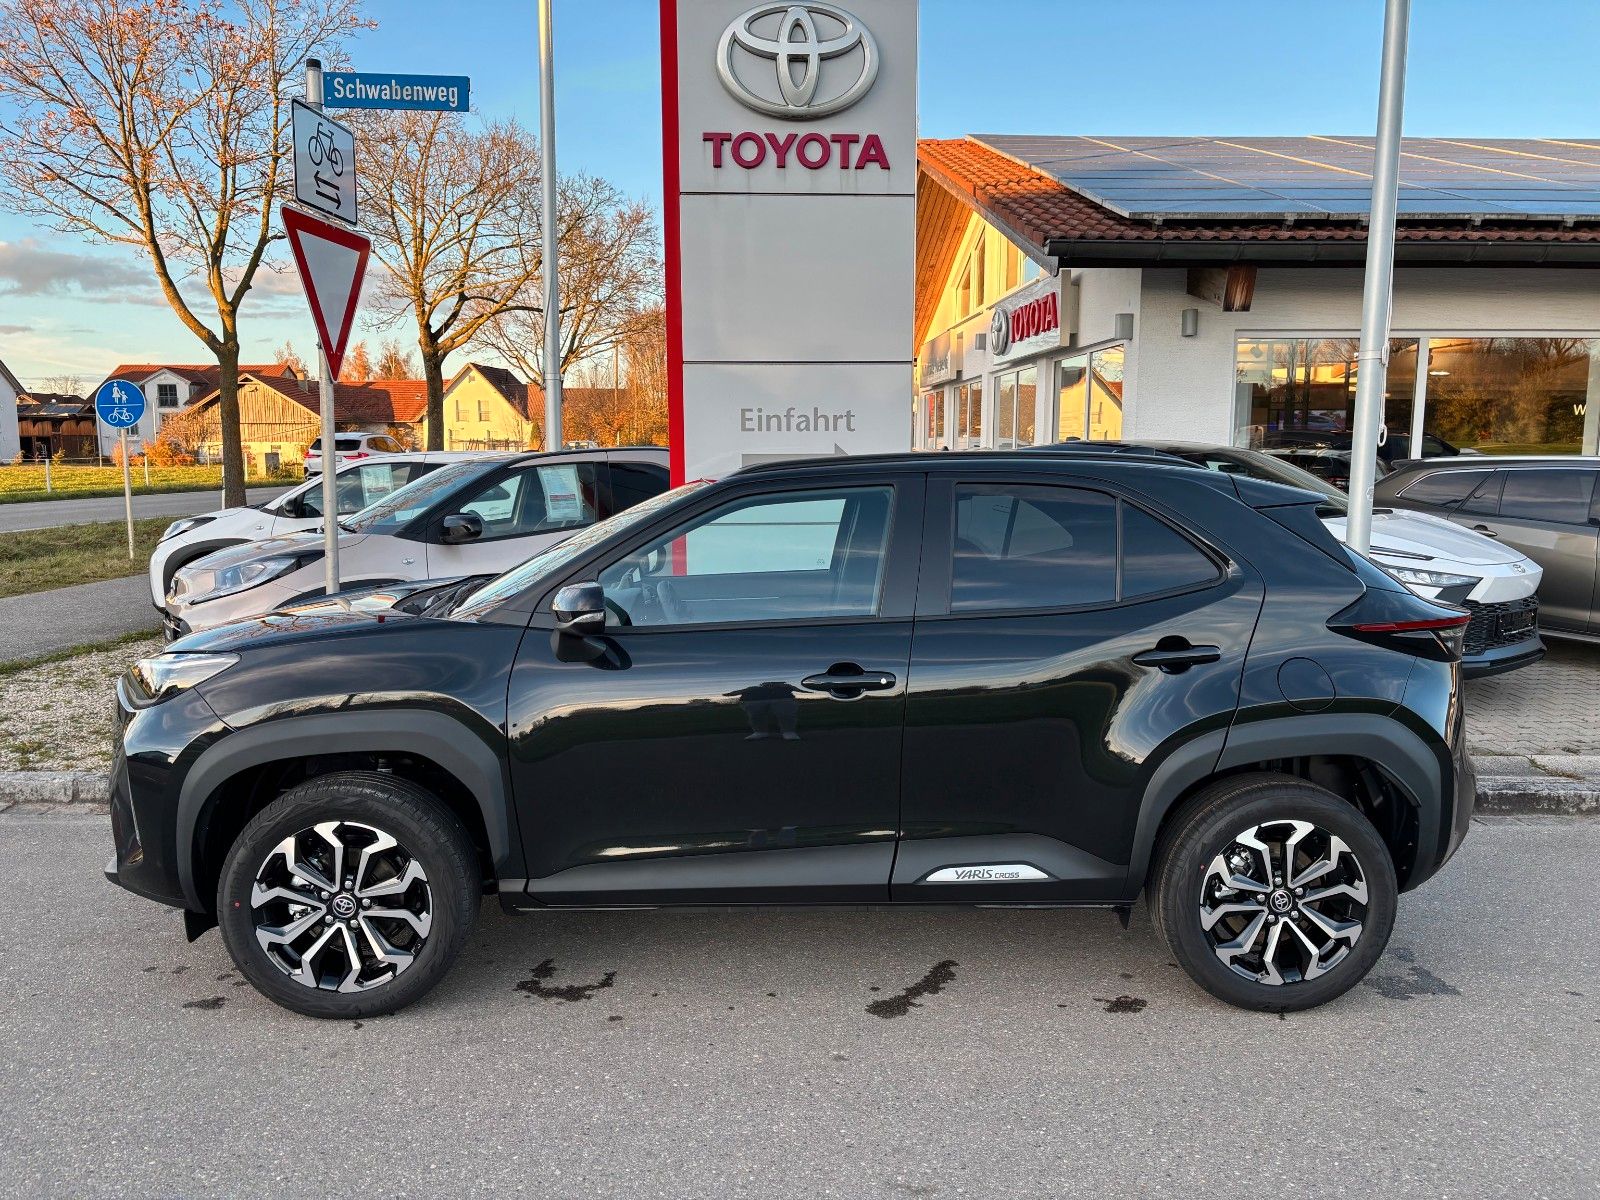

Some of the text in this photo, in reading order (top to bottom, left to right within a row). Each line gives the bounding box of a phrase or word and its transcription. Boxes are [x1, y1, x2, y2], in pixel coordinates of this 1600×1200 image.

[333, 77, 458, 108] Schwabenweg
[703, 131, 891, 170] TOYOTA
[1010, 292, 1059, 343] TOYOTA
[740, 406, 856, 432] Einfahrt
[954, 868, 1020, 880] YARIS CROSS
